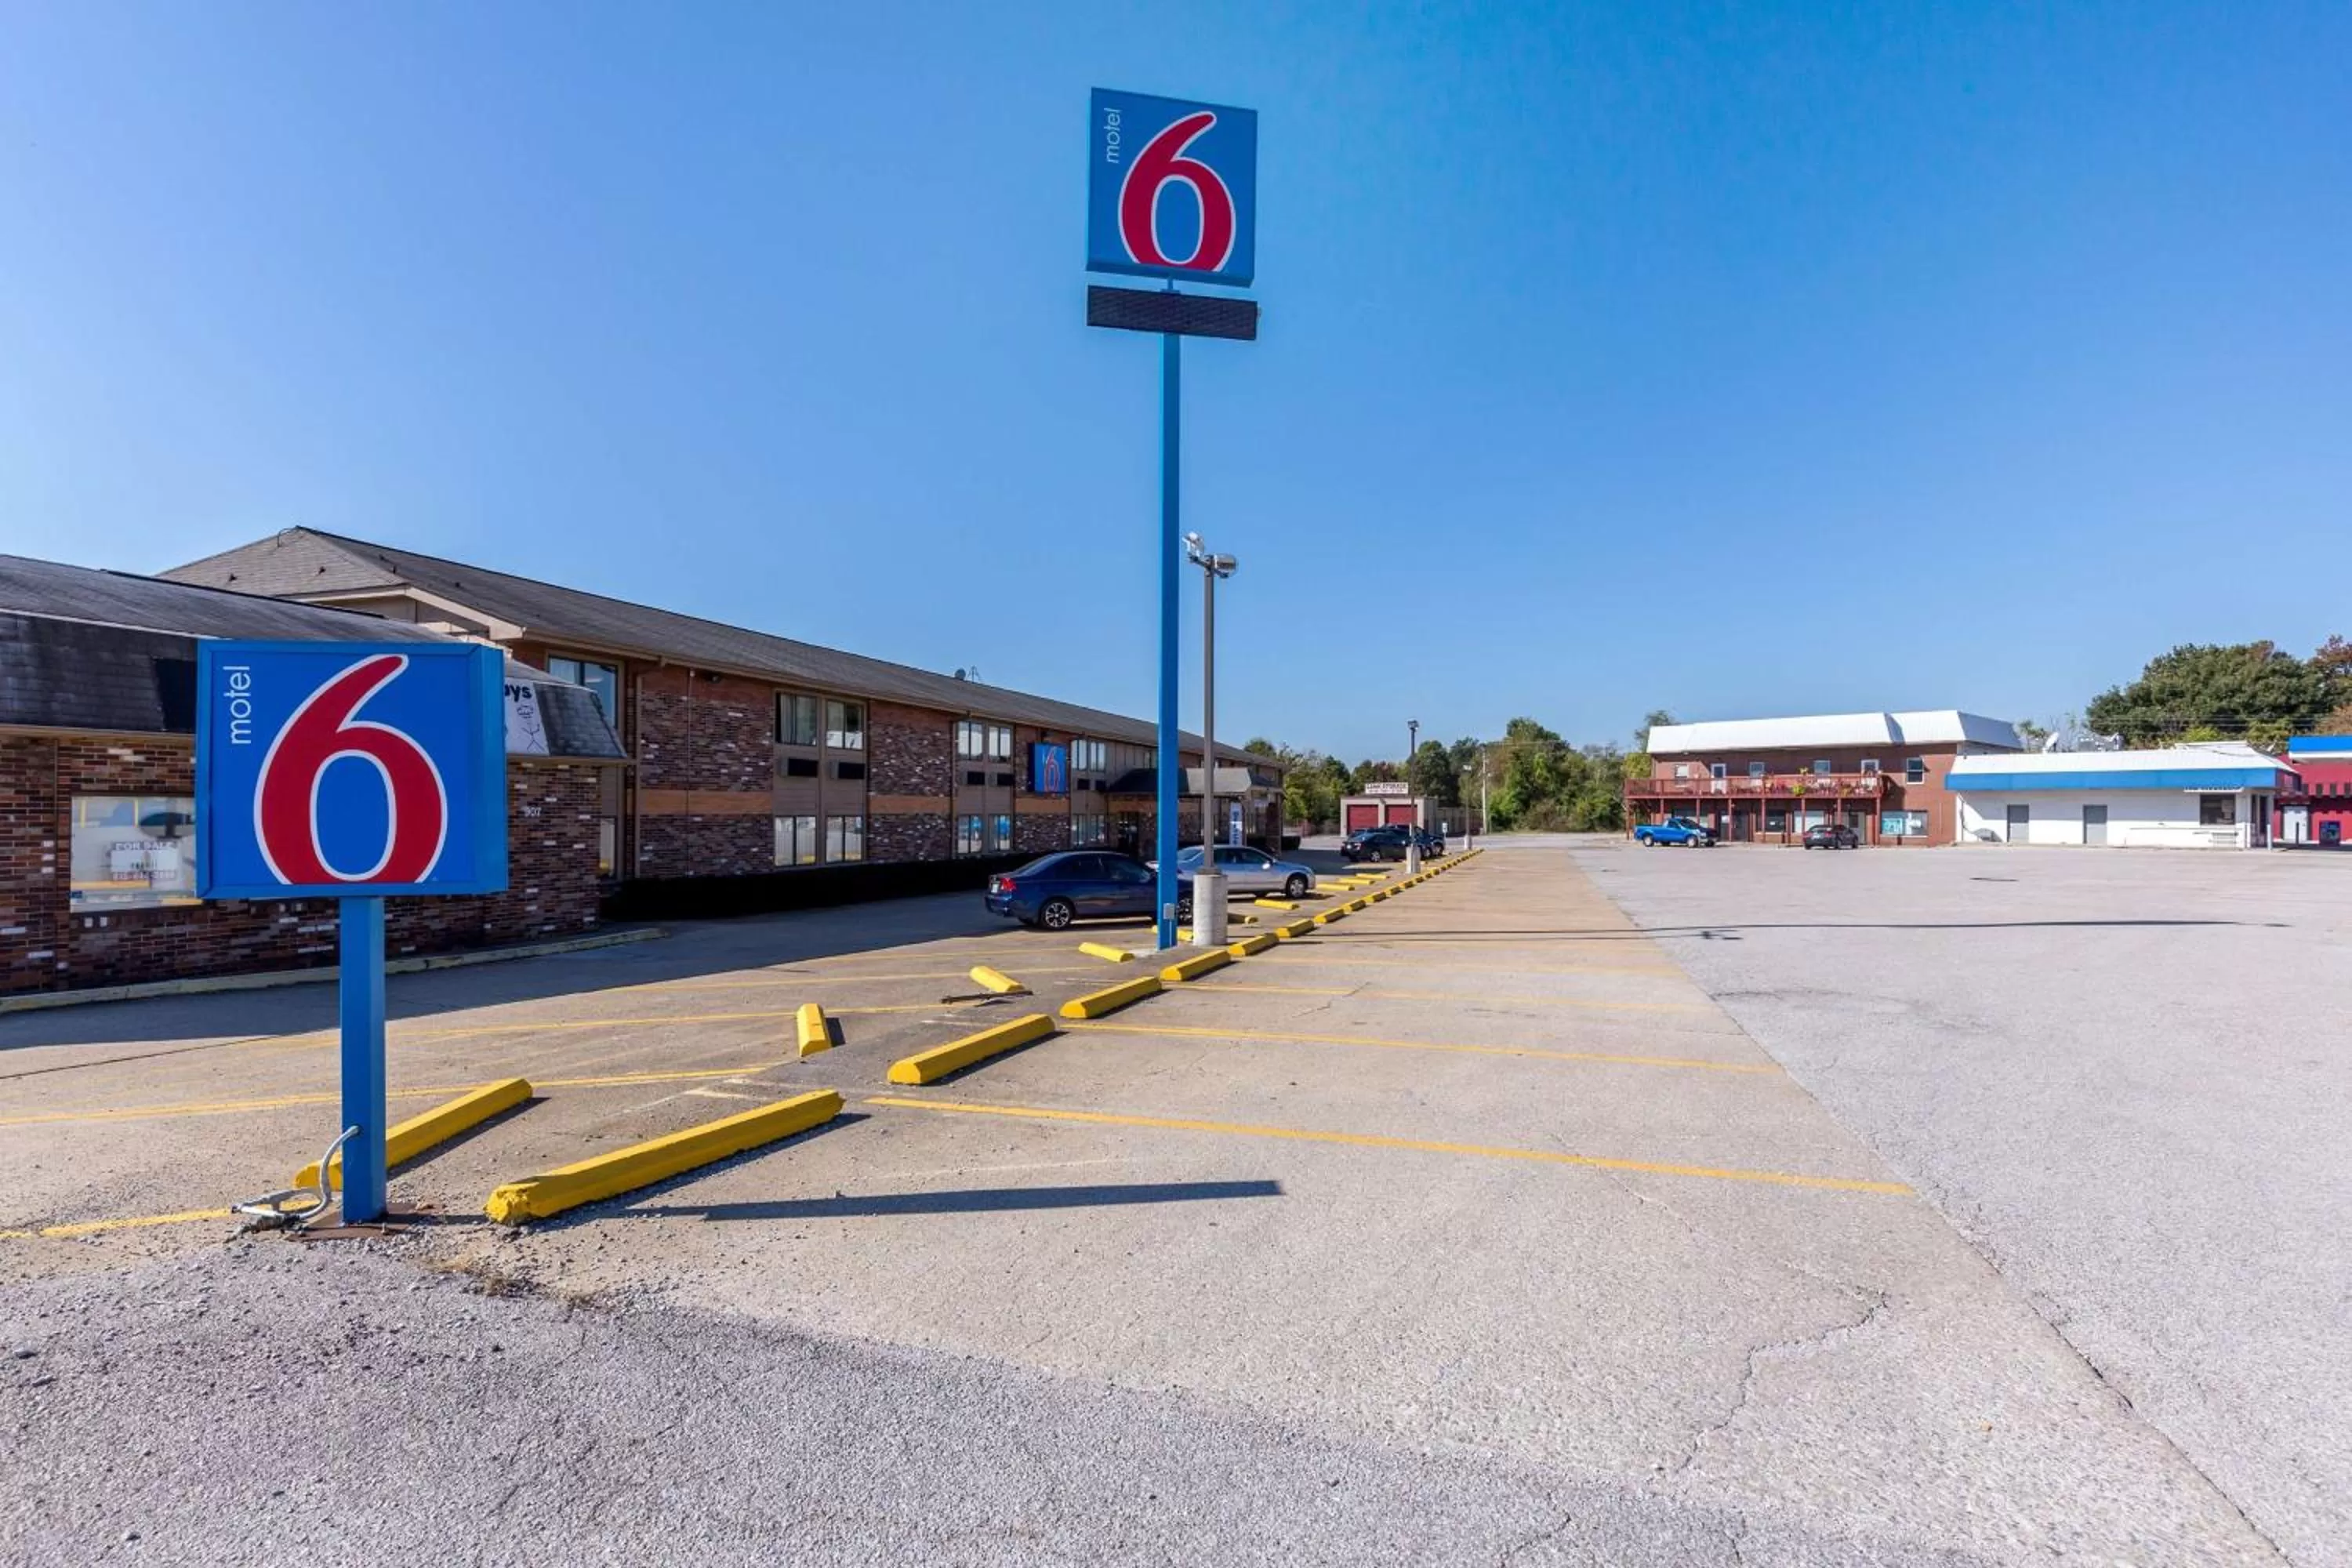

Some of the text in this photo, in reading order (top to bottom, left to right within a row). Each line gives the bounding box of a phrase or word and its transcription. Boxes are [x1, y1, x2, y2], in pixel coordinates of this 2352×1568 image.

[1104, 107, 1236, 272] motel 6
[223, 654, 448, 885] motel 6
